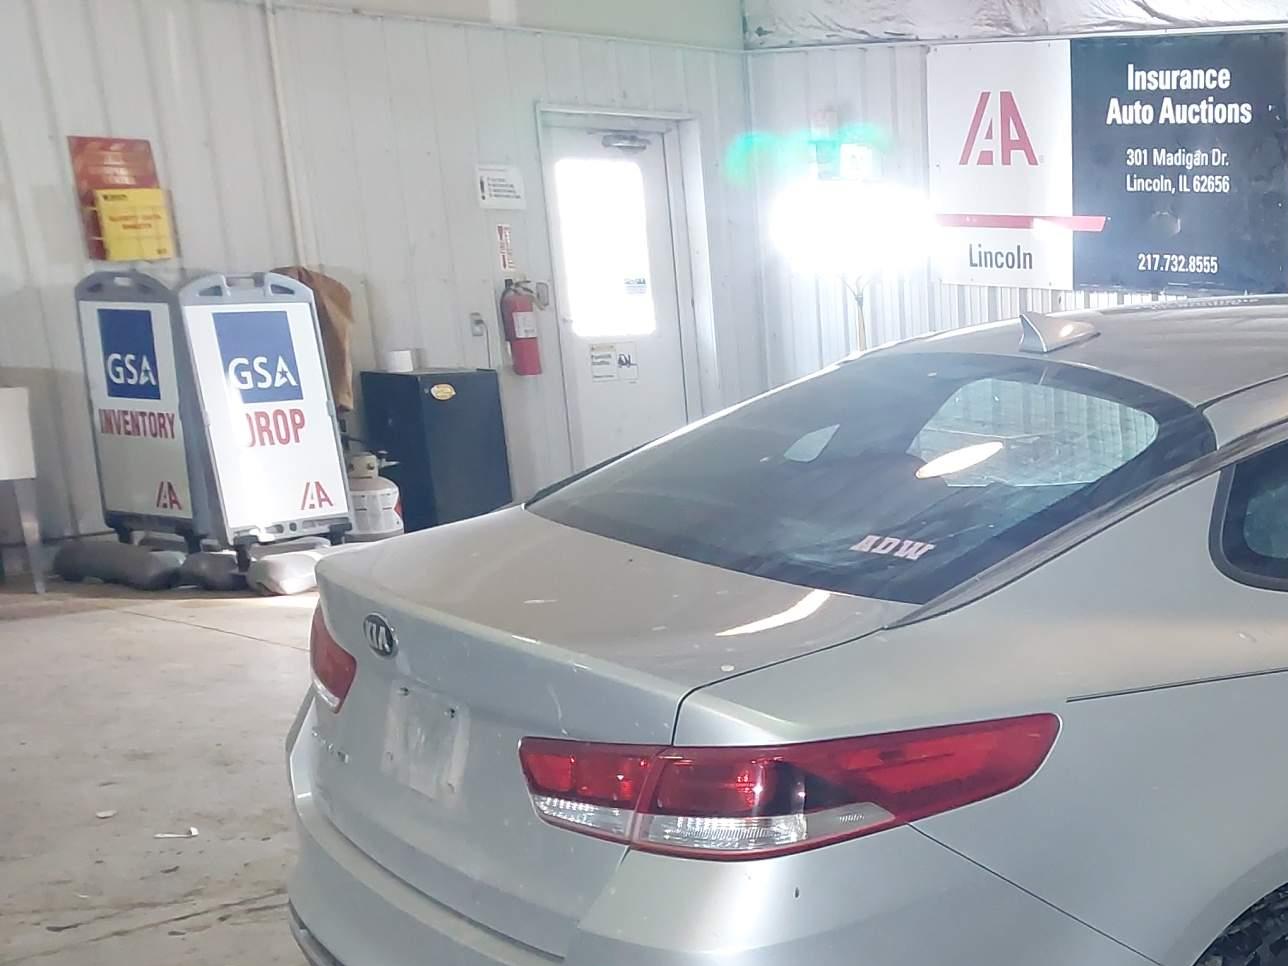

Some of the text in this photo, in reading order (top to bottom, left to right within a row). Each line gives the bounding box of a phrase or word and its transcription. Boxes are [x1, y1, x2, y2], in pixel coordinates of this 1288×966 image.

[1127, 63, 1231, 91] Insurance
[1105, 96, 1253, 126] Auto Auctions
[1126, 148, 1229, 170] 301 Madigan Dr.
[1126, 175, 1230, 194] Lincoln, IL 62656
[969, 243, 1033, 270] Lincoln
[1137, 253, 1219, 274] 217.732.8555
[107, 353, 157, 385] GSA
[228, 355, 299, 390] GSA
[98, 408, 176, 440] INVENTORY
[848, 534, 937, 561] ADW
